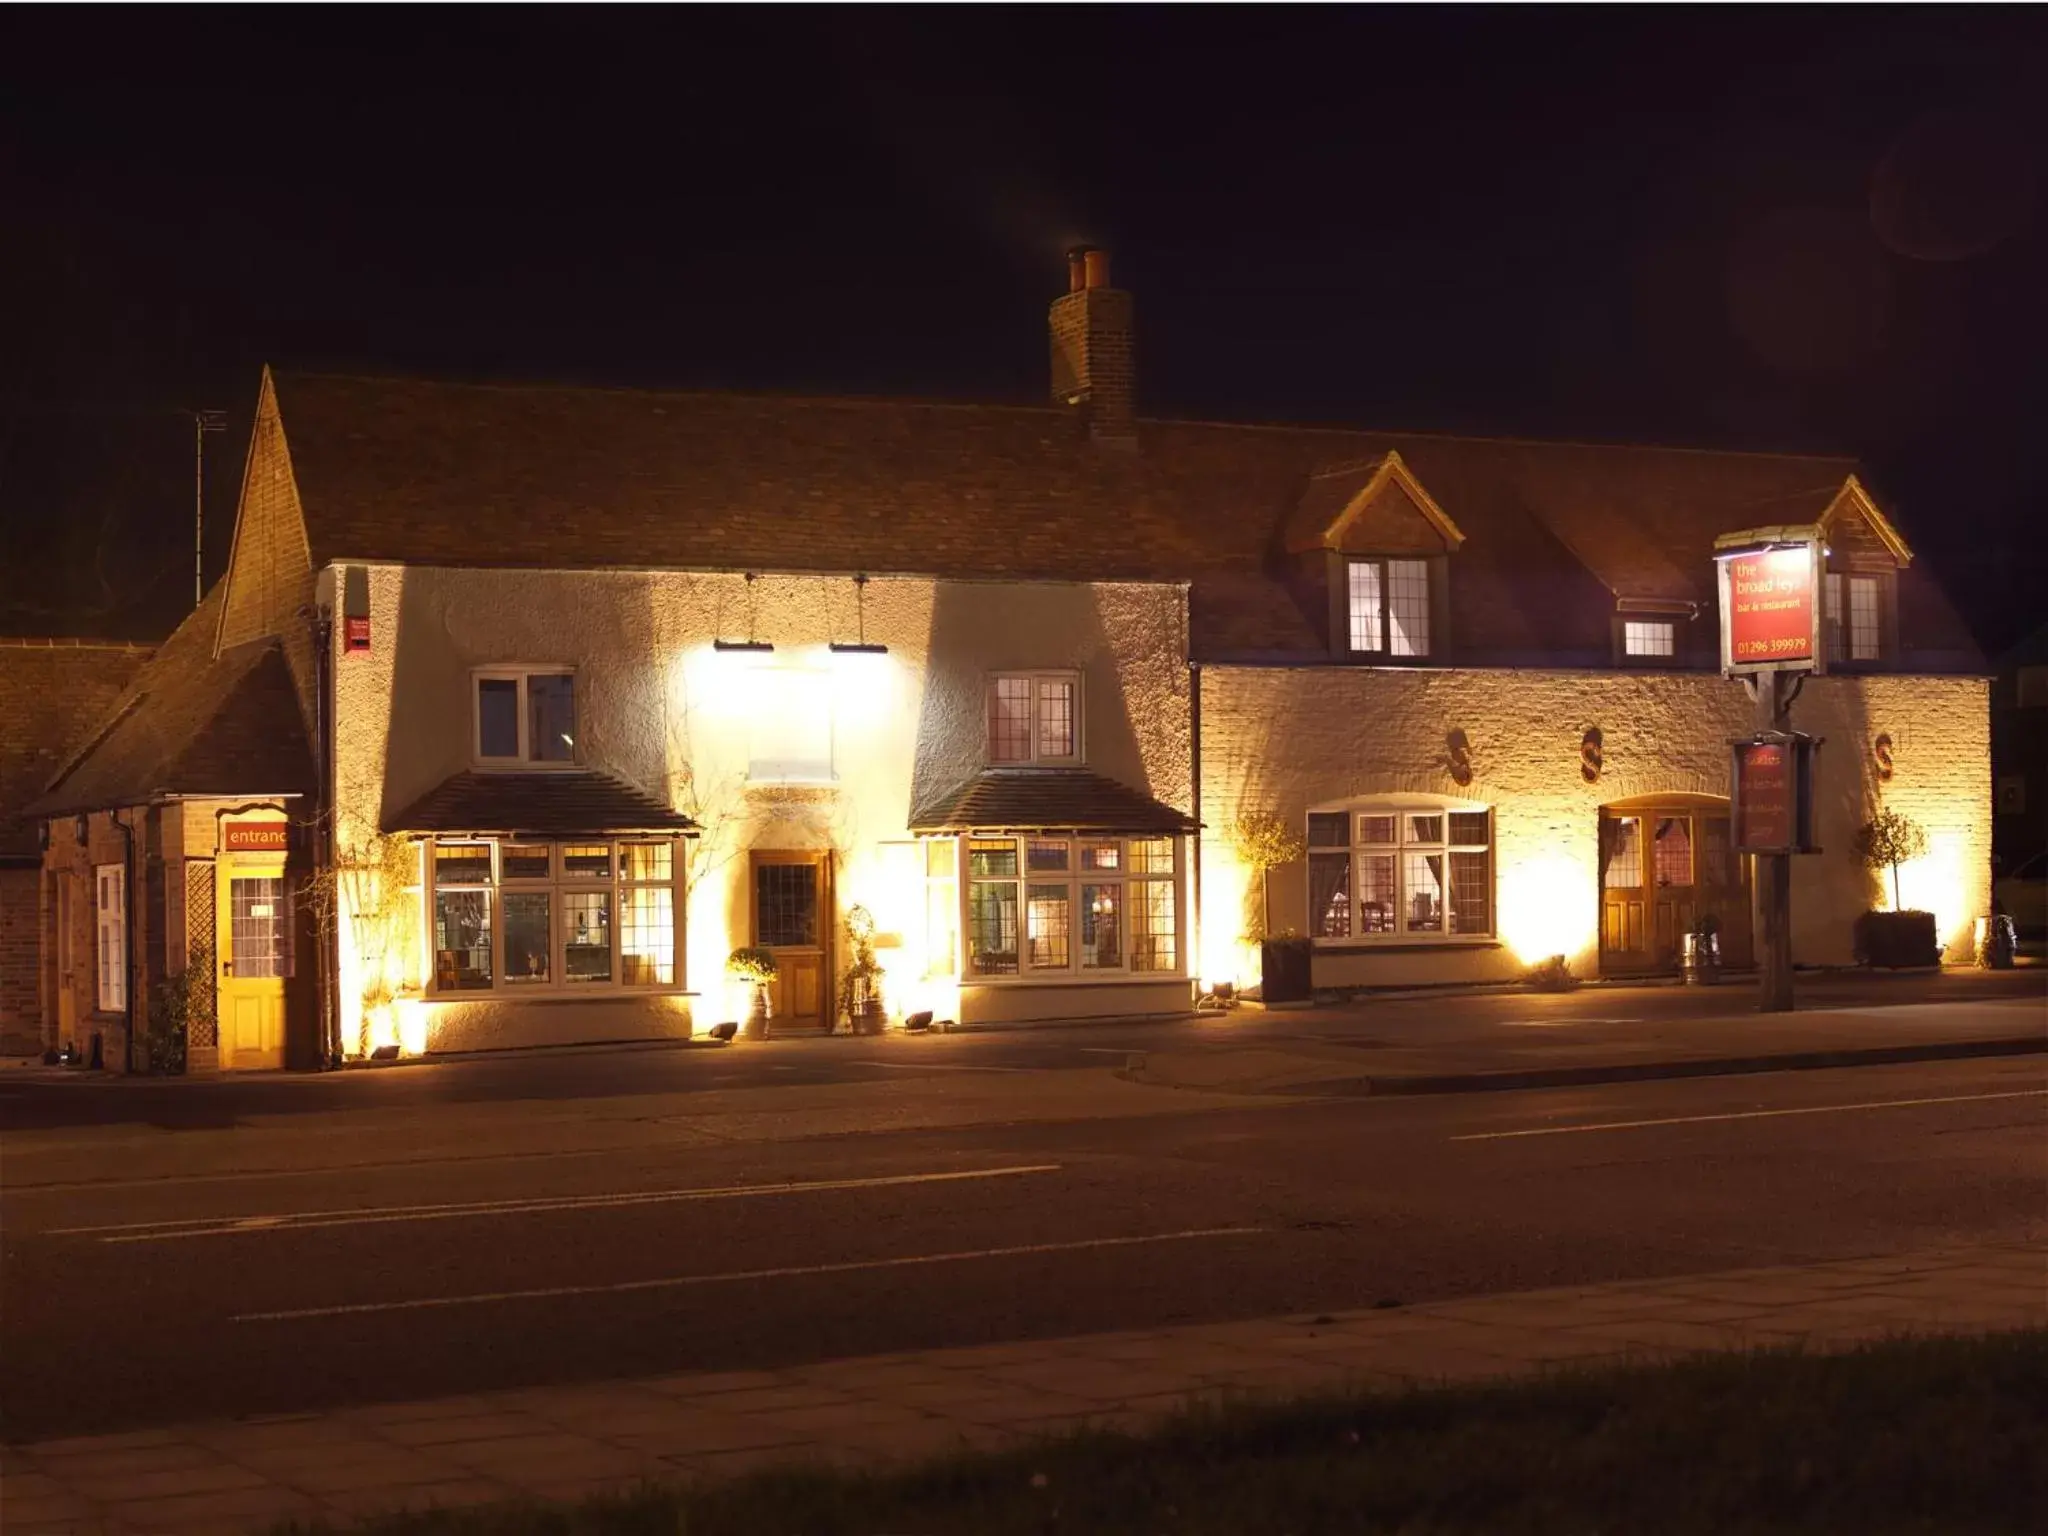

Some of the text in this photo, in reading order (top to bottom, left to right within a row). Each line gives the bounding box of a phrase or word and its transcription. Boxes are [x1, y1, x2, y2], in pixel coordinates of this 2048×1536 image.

[1737, 561, 1757, 577] the
[1736, 578, 1772, 594] broad
[1737, 601, 1749, 613] bar
[1760, 596, 1800, 611] restaurant
[1738, 638, 1806, 654] 01296 399979
[230, 829, 287, 843] entranc
